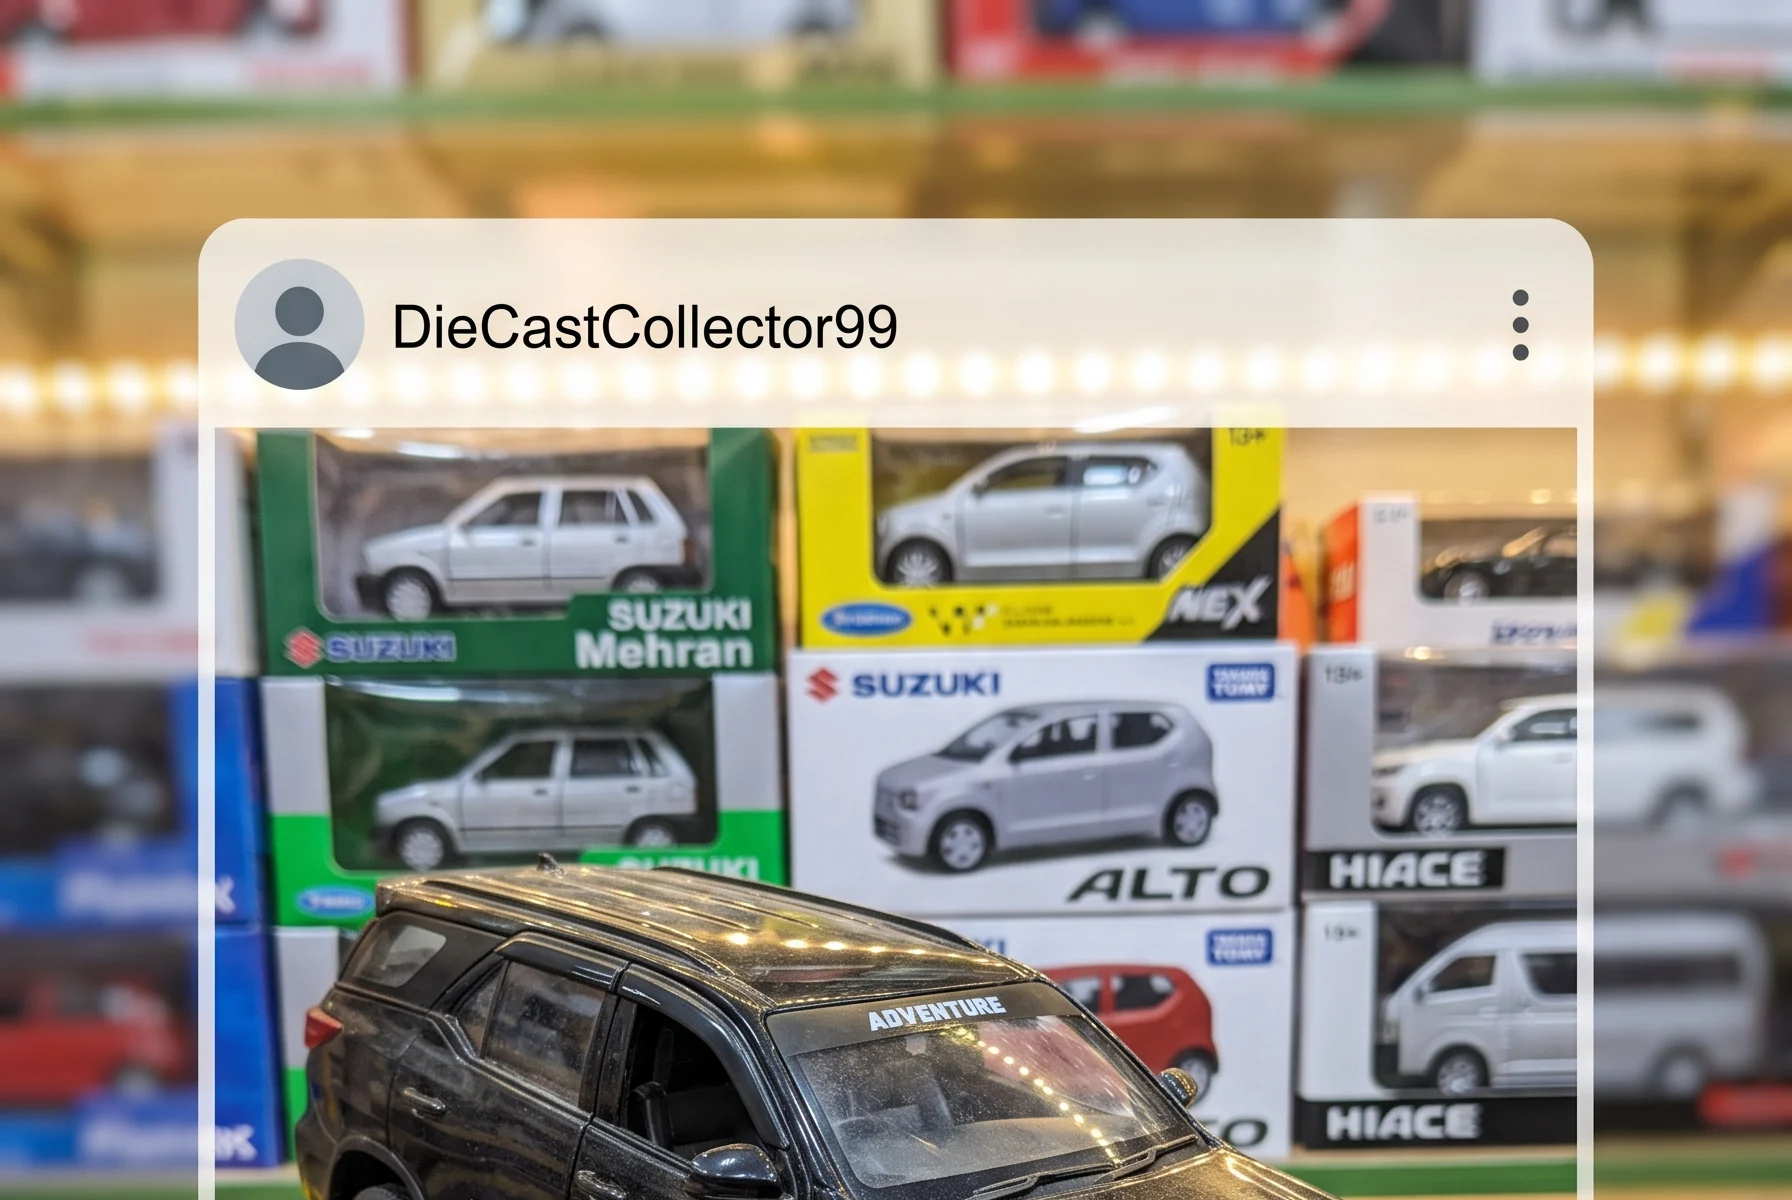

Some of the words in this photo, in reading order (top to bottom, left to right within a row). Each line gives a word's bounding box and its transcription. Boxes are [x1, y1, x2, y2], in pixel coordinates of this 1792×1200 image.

[608, 598, 752, 631] SUZUKI
[1169, 575, 1272, 629] NEX
[325, 630, 457, 663] SUZUKI
[574, 630, 754, 668] Mehran
[852, 671, 1000, 698] SUZUKI
[1066, 865, 1271, 902] ALTO
[1328, 850, 1487, 889] HIACE
[868, 996, 1007, 1031] ADVENTURE
[1326, 1103, 1482, 1141] HIACE
